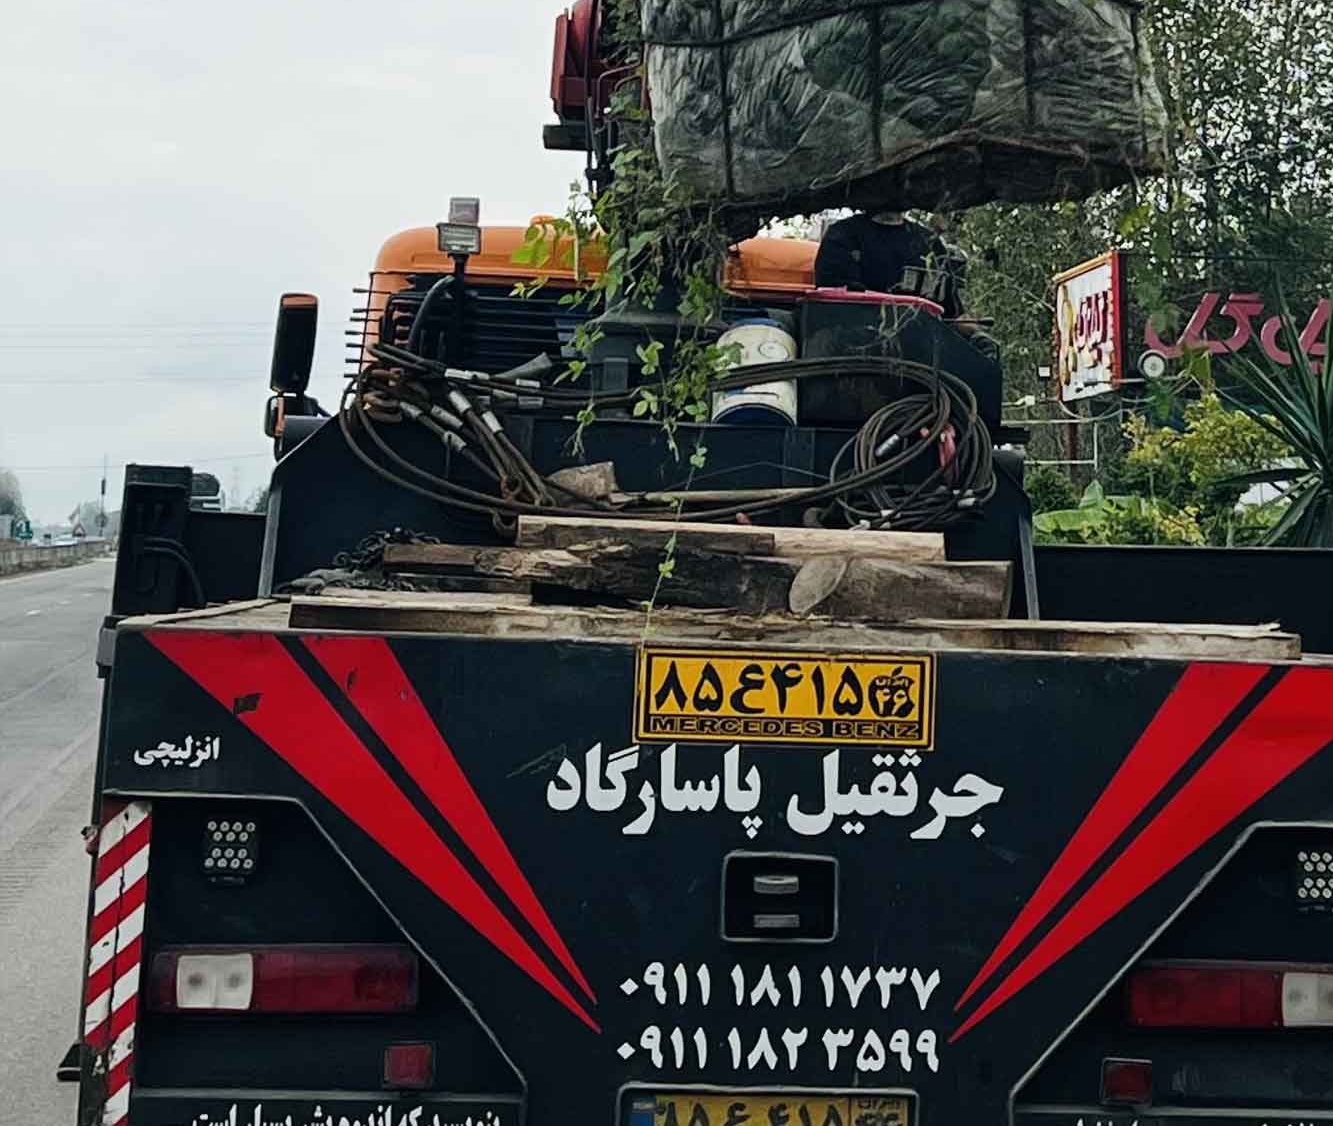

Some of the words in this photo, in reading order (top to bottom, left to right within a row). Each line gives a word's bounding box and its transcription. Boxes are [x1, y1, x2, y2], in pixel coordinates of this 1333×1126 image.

[133, 735, 220, 767] انزلیچی
[651, 717, 823, 736] MERCEDES
[832, 721, 920, 739] BENZ
[546, 742, 763, 840] پاسارگاد
[787, 749, 1004, 840] جرثقیل
[619, 962, 711, 1006] ۰۹۱۱
[731, 964, 802, 1008] ۱۸۱
[820, 965, 941, 1011] ۱۷۳۷
[616, 1025, 708, 1069] ۰۹۱۱
[727, 1027, 809, 1071] ۱۸۲
[822, 1029, 939, 1073] ۳۵۹۹
